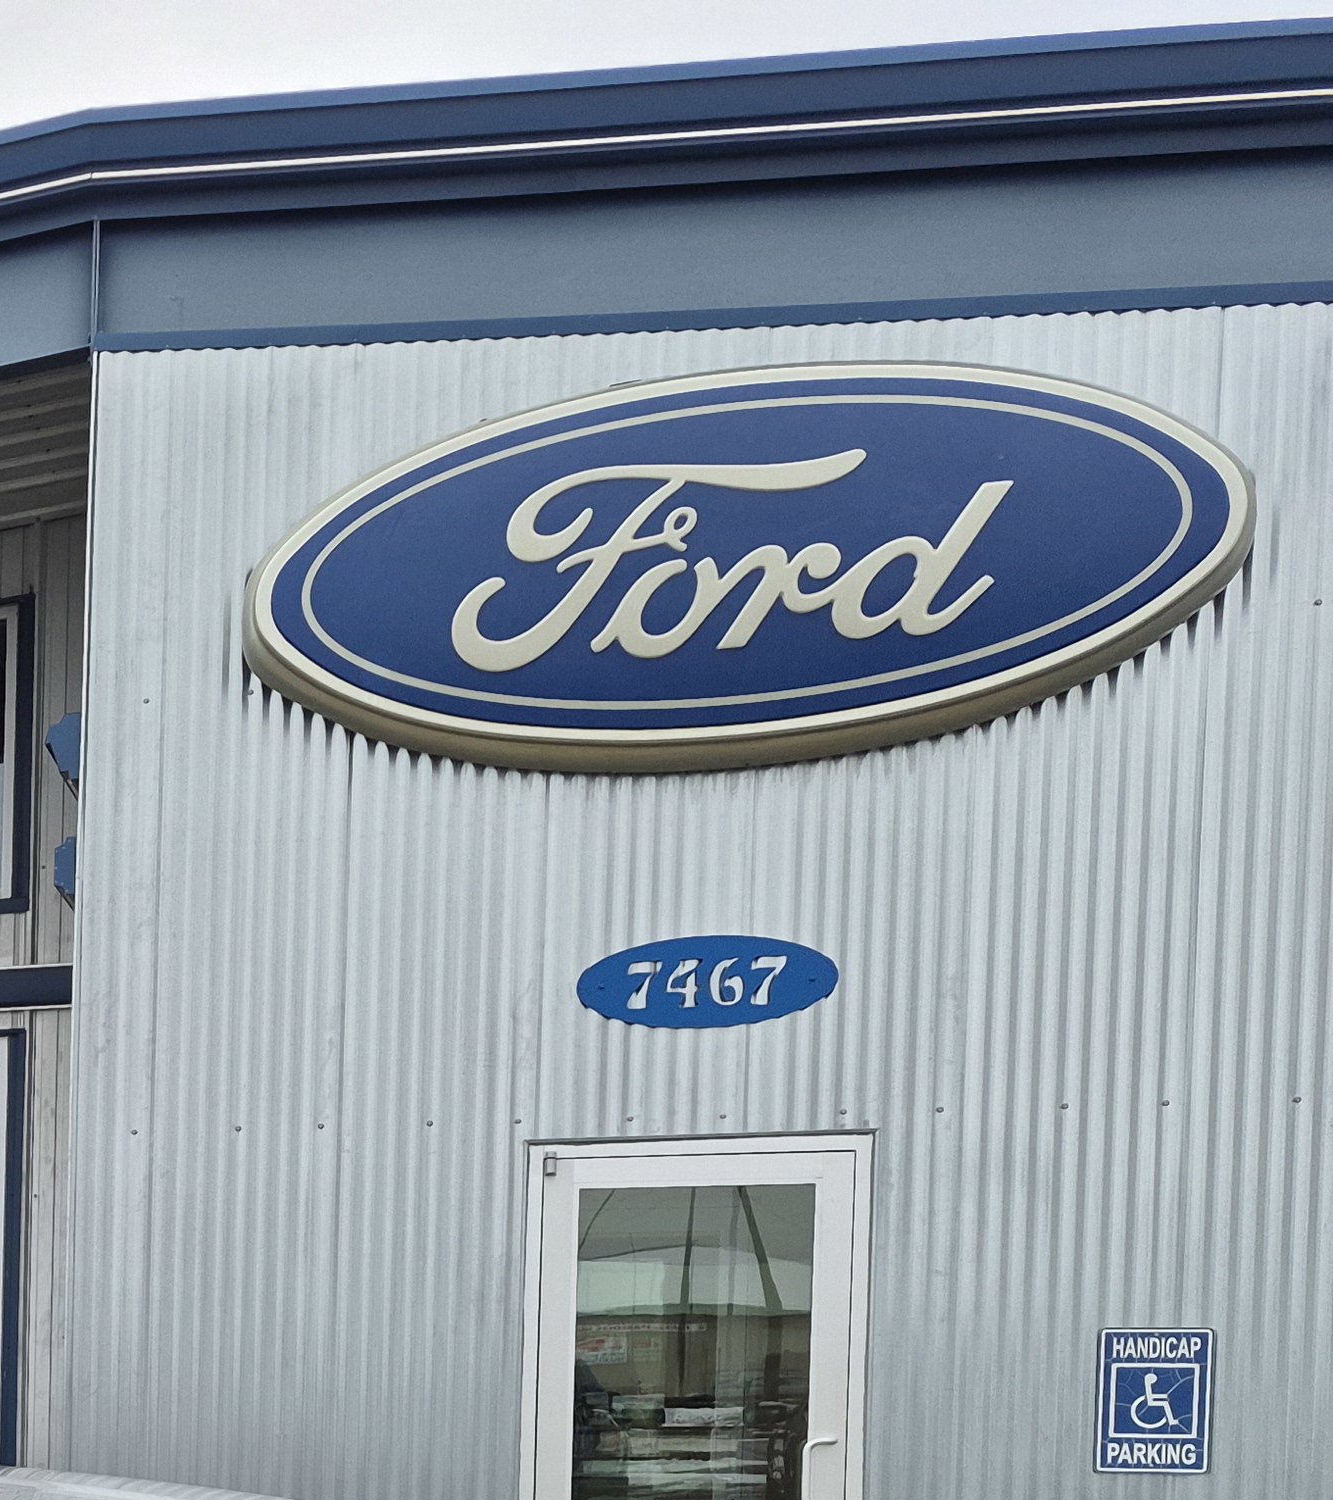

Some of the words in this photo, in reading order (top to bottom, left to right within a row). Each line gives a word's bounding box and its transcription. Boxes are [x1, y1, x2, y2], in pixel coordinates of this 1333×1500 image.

[451, 447, 1015, 673] Ford
[627, 955, 788, 1010] 7467
[1112, 1337, 1202, 1359] HANDICAP
[1107, 1443, 1196, 1465] PARKING
